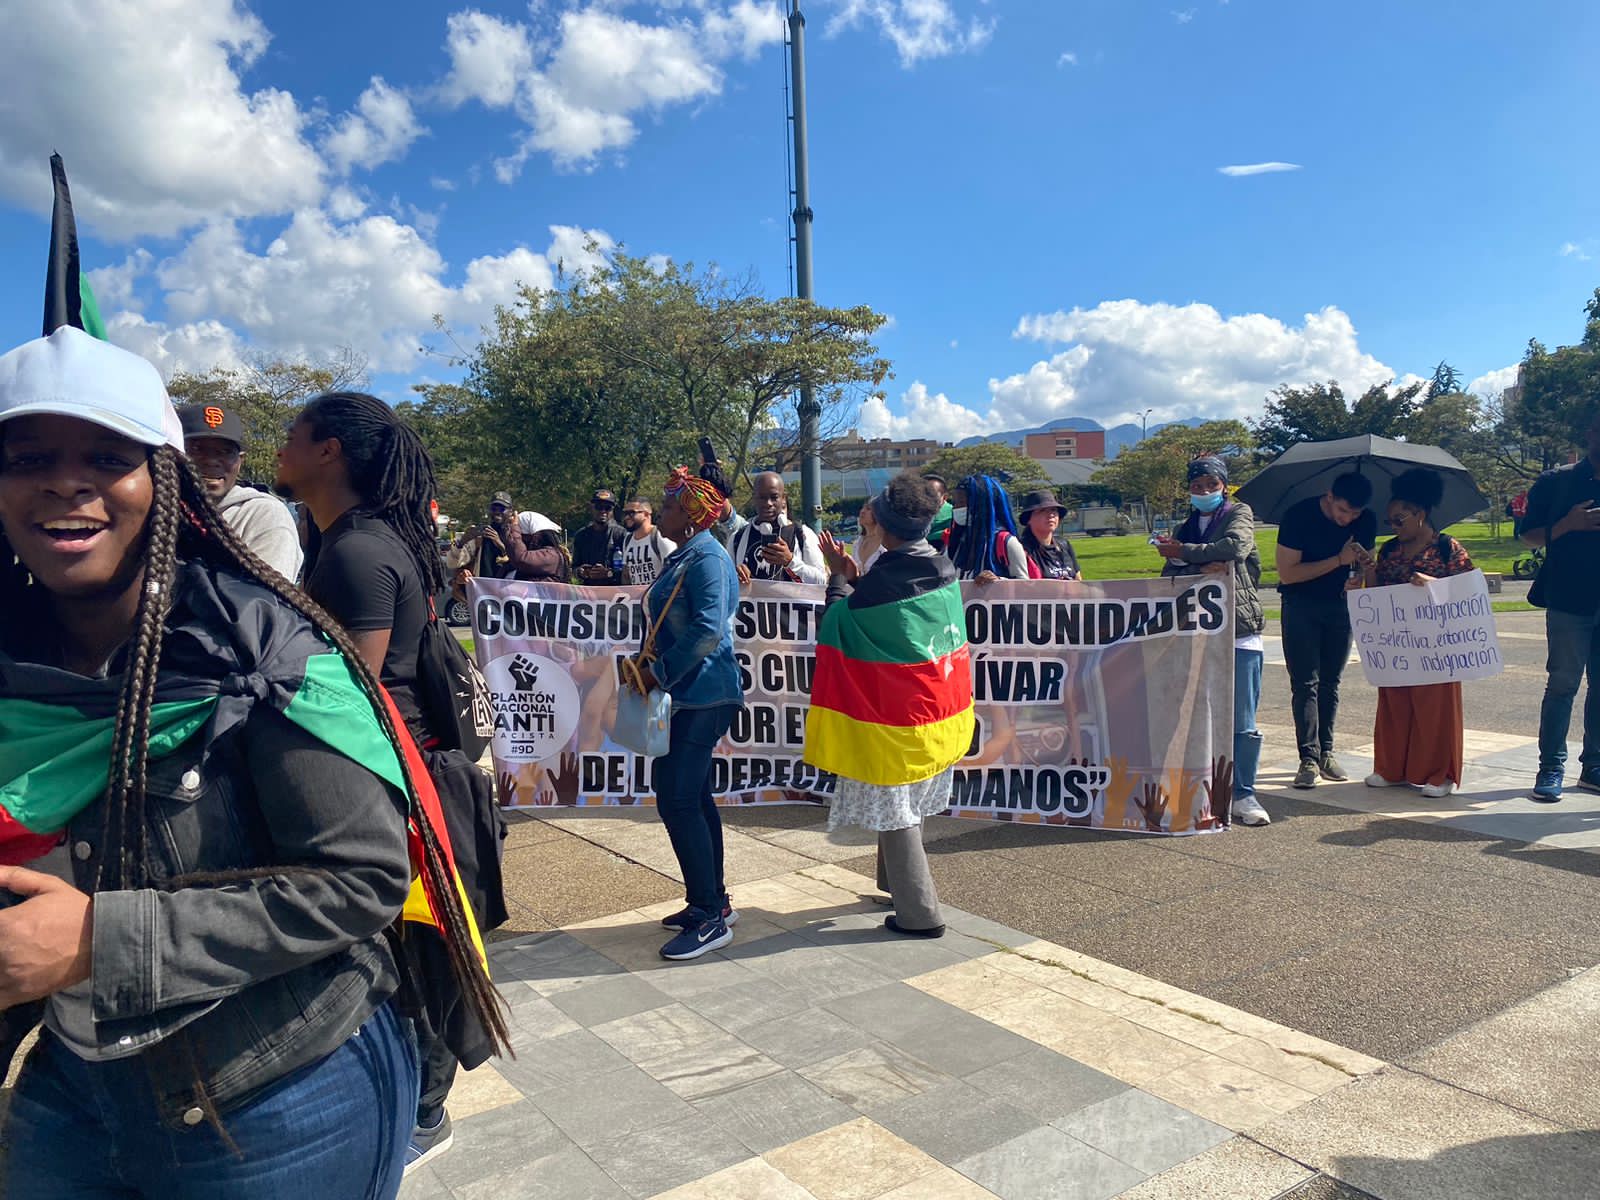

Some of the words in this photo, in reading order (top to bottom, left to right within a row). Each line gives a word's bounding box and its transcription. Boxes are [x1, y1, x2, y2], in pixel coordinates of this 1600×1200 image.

[626, 545, 652, 565] ALL
[630, 563, 655, 575] OWER
[735, 600, 825, 640] SULT
[964, 584, 1224, 646] OMUNIDADES
[1390, 594, 1407, 624] la
[1414, 592, 1491, 629] indignación
[1360, 632, 1374, 645] es
[1436, 626, 1488, 647] entonces
[1366, 650, 1386, 670] NO
[1392, 655, 1409, 671] es
[1420, 644, 1499, 677] indignación
[761, 653, 817, 695] CIU
[973, 652, 1064, 702] ÍVAR
[490, 691, 556, 704] PLANTÓN
[494, 713, 555, 733] ANTI
[729, 705, 776, 743] OR
[511, 745, 535, 754] #9D
[582, 755, 625, 793] DE
[711, 757, 839, 794] DERECH
[949, 767, 1107, 814] MANOS”
